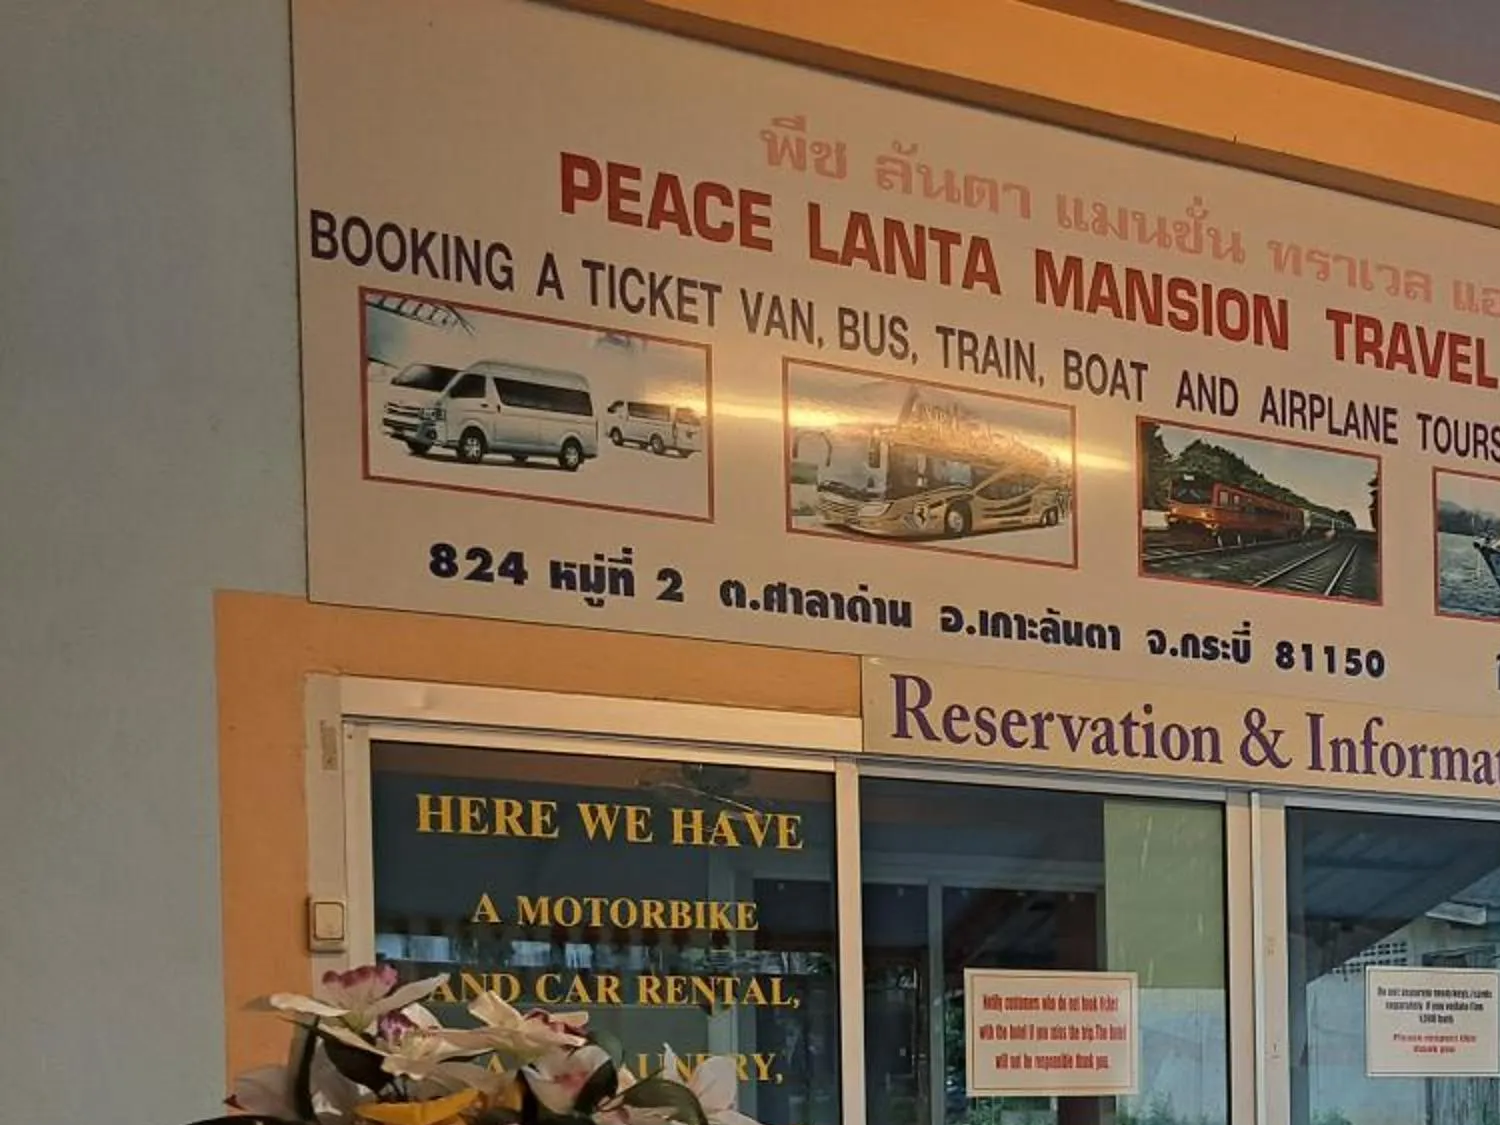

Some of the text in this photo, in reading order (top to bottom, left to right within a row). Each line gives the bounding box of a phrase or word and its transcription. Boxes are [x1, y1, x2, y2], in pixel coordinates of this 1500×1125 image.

[760, 115, 847, 179] พีช
[875, 140, 1031, 219] ลันตา
[1056, 196, 1246, 264] แมนชั่น
[1267, 238, 1433, 302] ทราเวล
[310, 209, 514, 291] BOOKING
[536, 254, 564, 299] A
[582, 259, 722, 328] TICKET
[741, 288, 825, 349] VAN,
[838, 307, 919, 364] BUS,
[936, 325, 1045, 388] TRAIN,
[1063, 350, 1149, 403] BOAT
[1175, 371, 1239, 417] AND
[1260, 386, 1399, 446] AIRPLANE
[559, 151, 774, 253] PEACE
[808, 202, 1000, 295] LANTA
[1034, 249, 1289, 351] MANSION
[1326, 308, 1499, 390] TRAVEL
[429, 543, 1386, 679] 824 หมู่ที่ 2 ต.ศาลาด่าน อ.เกาะลันตา จ.กระบี่ 81150
[890, 674, 1223, 766] Reservation
[1239, 707, 1293, 769] &
[416, 793, 803, 850] HERE WE HAVE
[471, 893, 759, 932] A MOTORBIKE
[428, 973, 801, 1010] AND CAR RENTAL,
